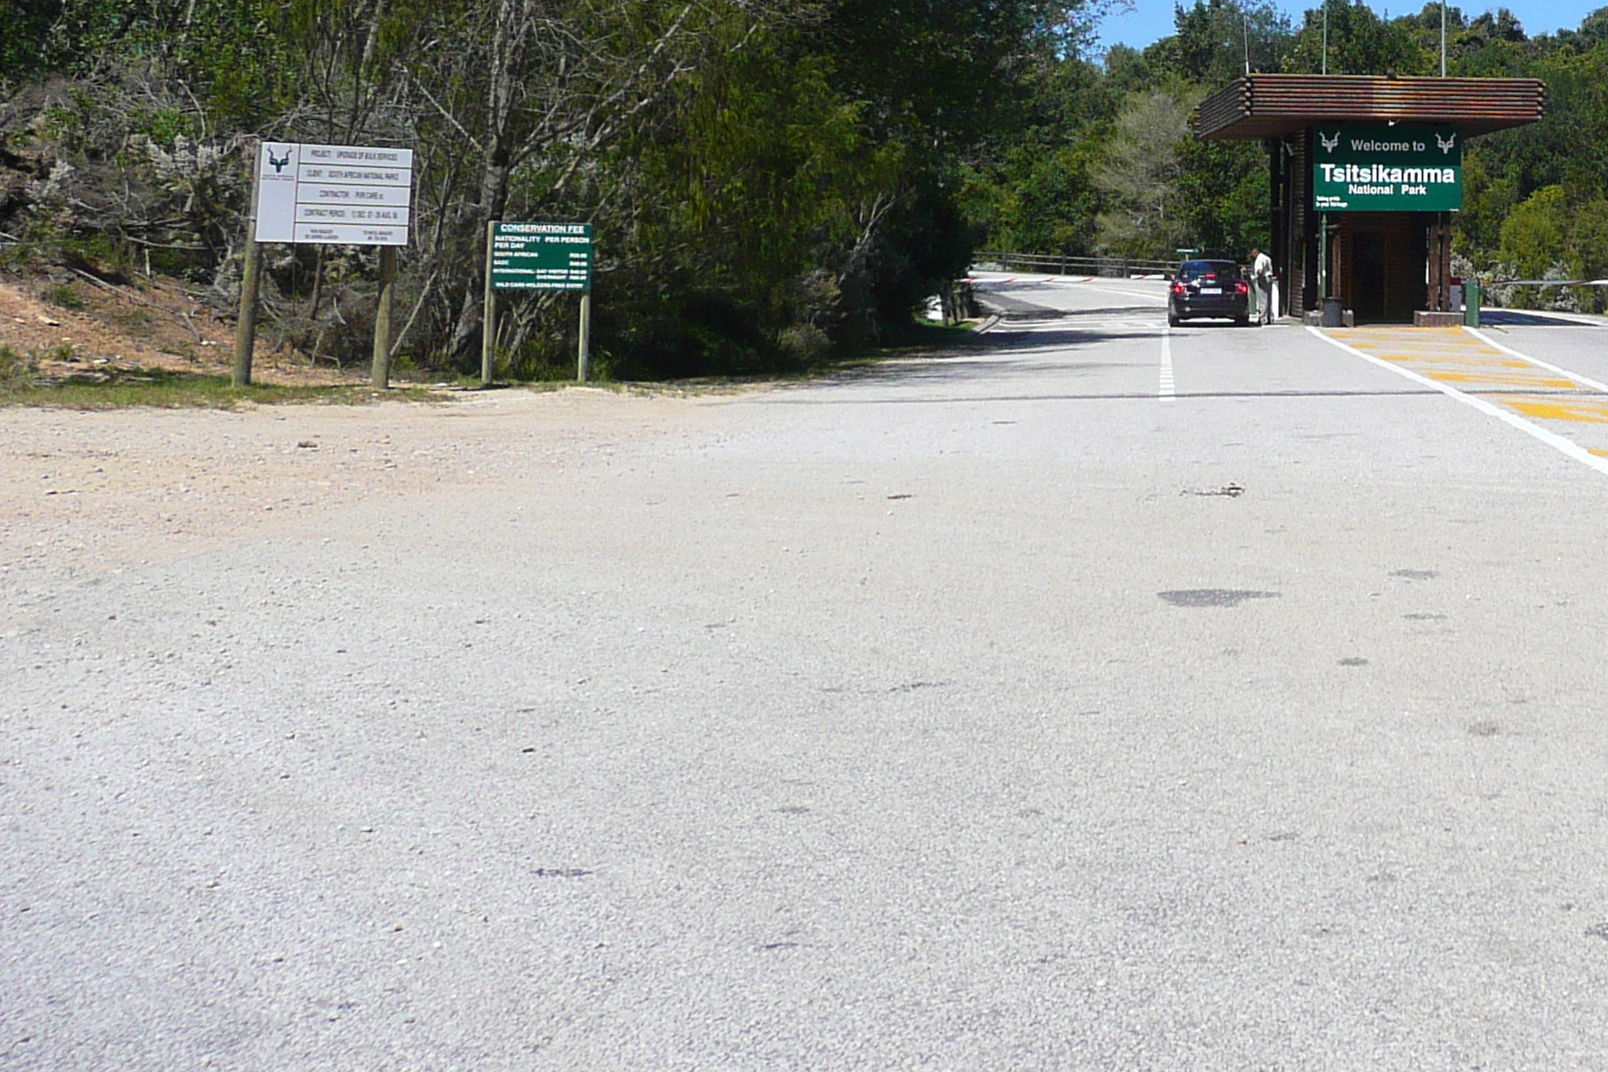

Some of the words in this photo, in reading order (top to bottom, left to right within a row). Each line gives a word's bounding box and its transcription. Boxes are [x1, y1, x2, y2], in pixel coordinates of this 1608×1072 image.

[1351, 139, 1410, 152] Welcome
[1413, 140, 1426, 152] to
[1320, 163, 1455, 183] Tsitsikamma
[1348, 184, 1394, 195] National
[1401, 184, 1427, 195] Park
[500, 224, 566, 233] CONSERVATION
[568, 225, 585, 234] FEE
[494, 235, 541, 243] NATIONALITY
[545, 236, 560, 244] PER
[561, 236, 590, 244] PERSON
